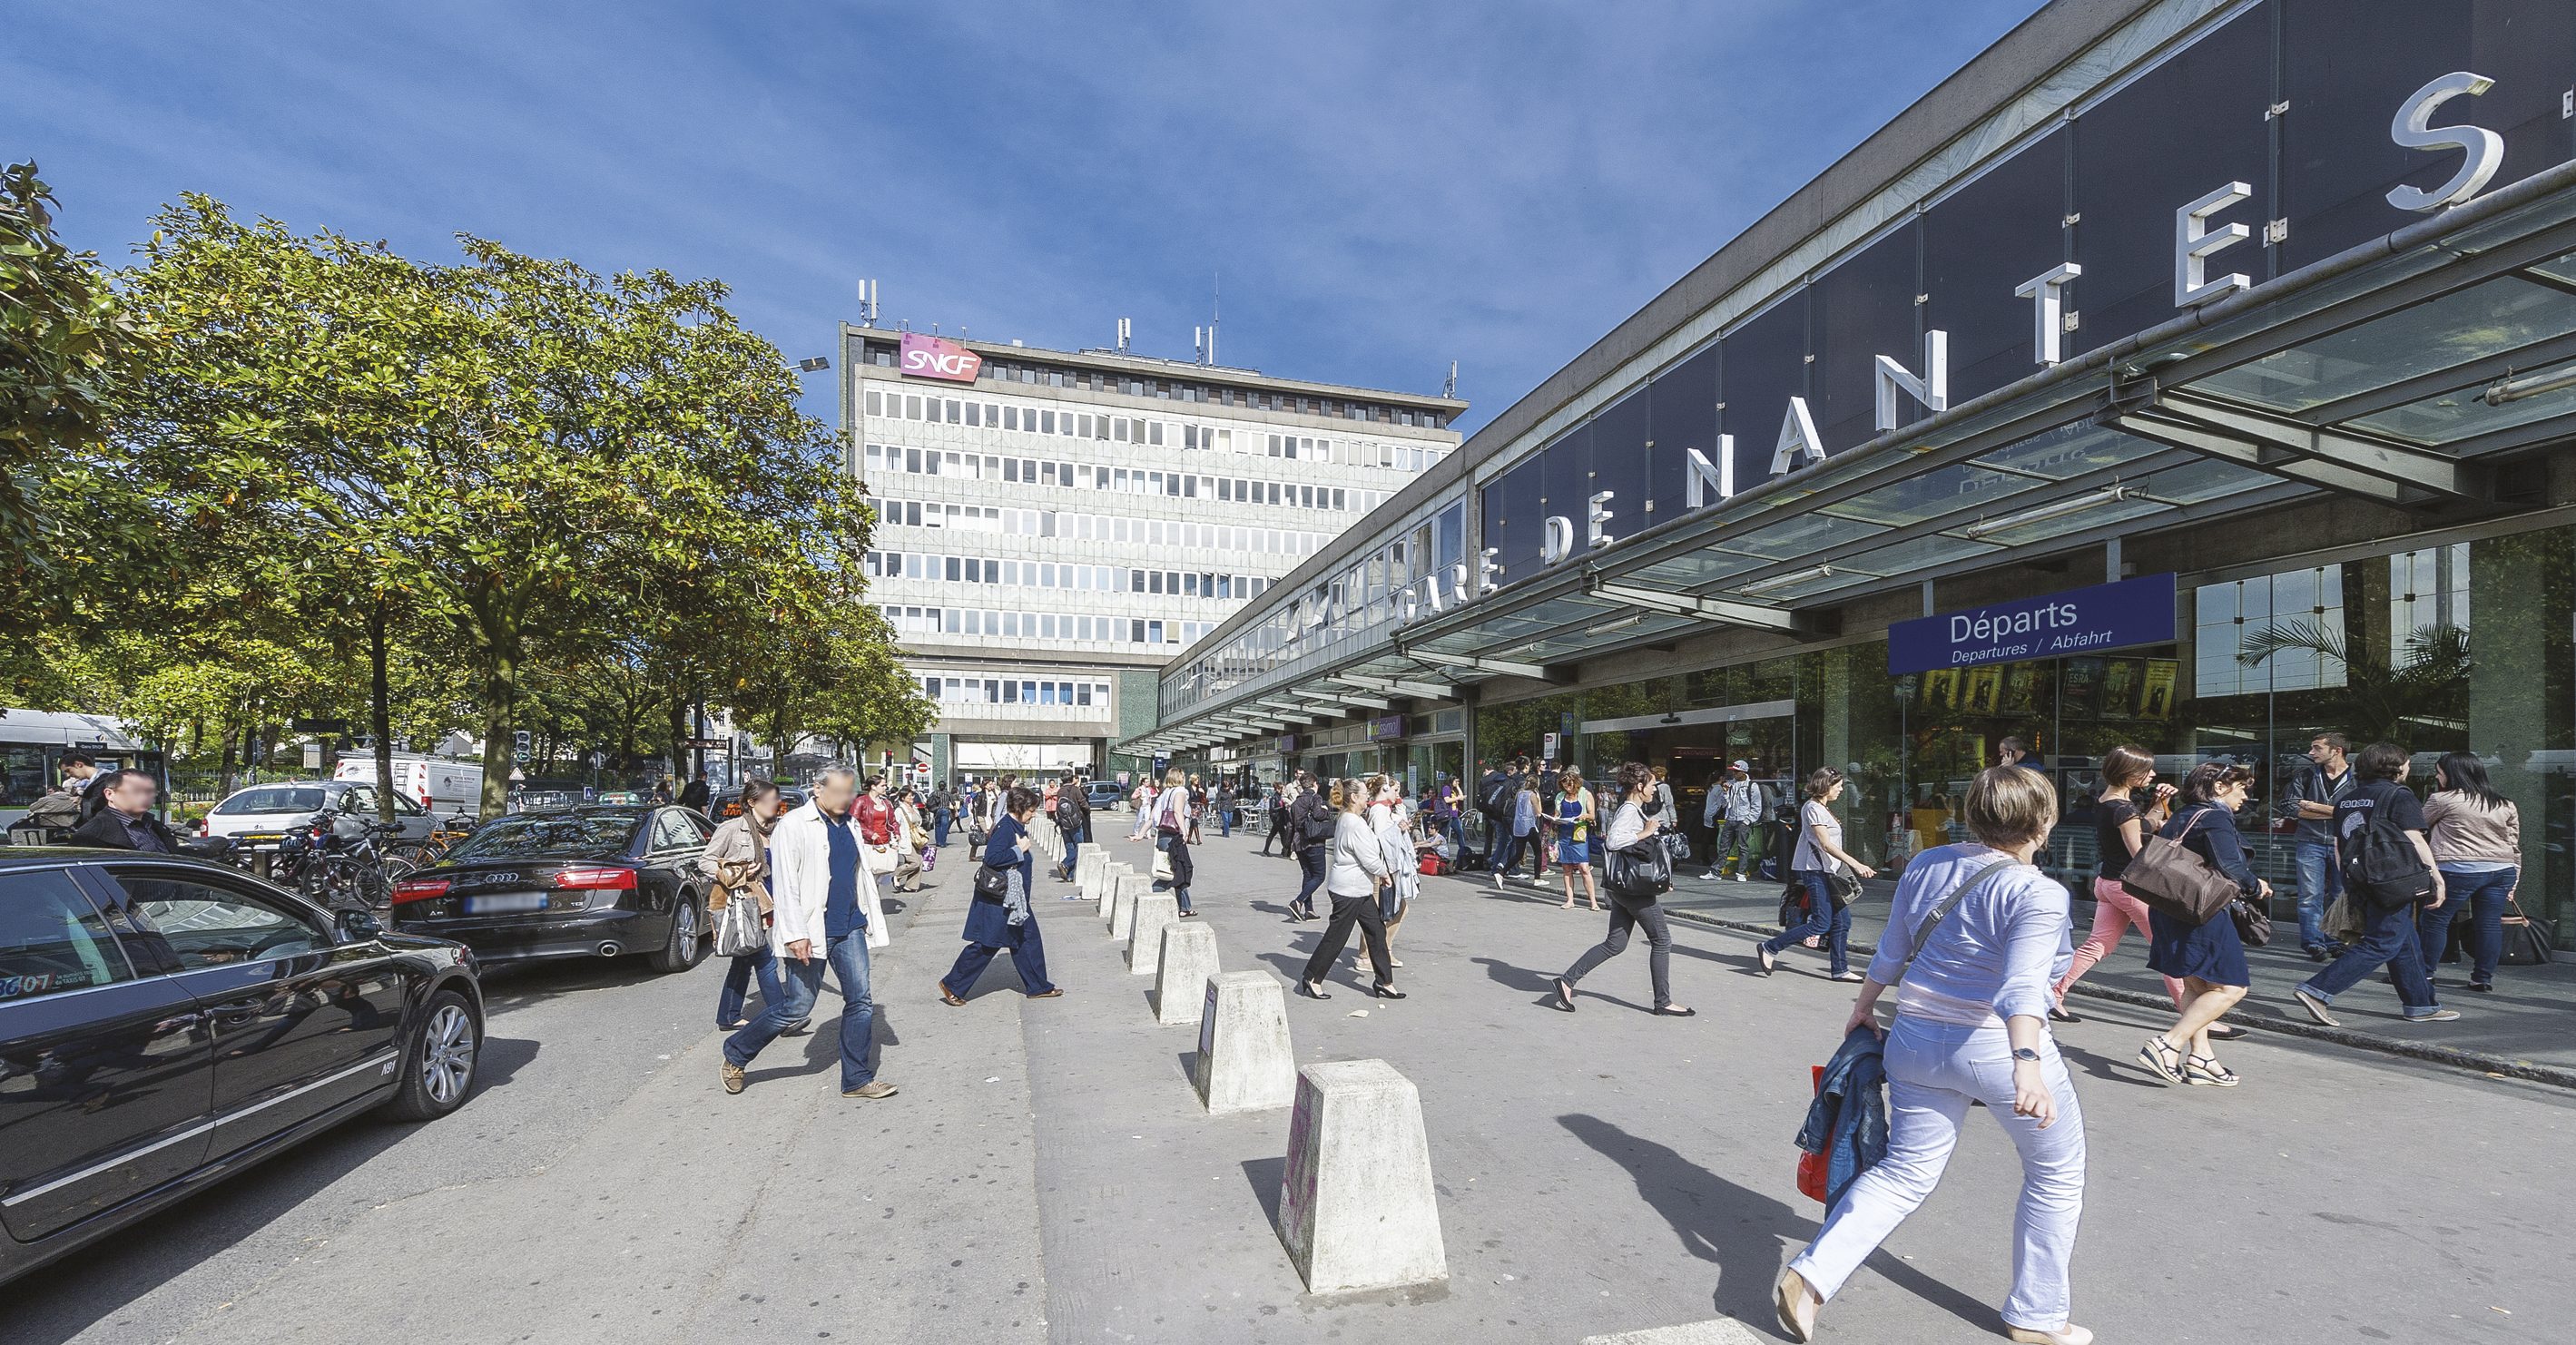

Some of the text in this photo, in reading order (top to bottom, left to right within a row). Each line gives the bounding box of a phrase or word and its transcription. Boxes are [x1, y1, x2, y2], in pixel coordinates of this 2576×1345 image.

[904, 350, 978, 375] SNCF
[1395, 547, 1499, 625] GARE
[1545, 490, 1614, 565] DE
[1686, 71, 2504, 509] NANTES
[1951, 602, 2078, 643] Départs
[1952, 643, 2028, 663] Departures
[2050, 630, 2113, 651] Abfahrt
